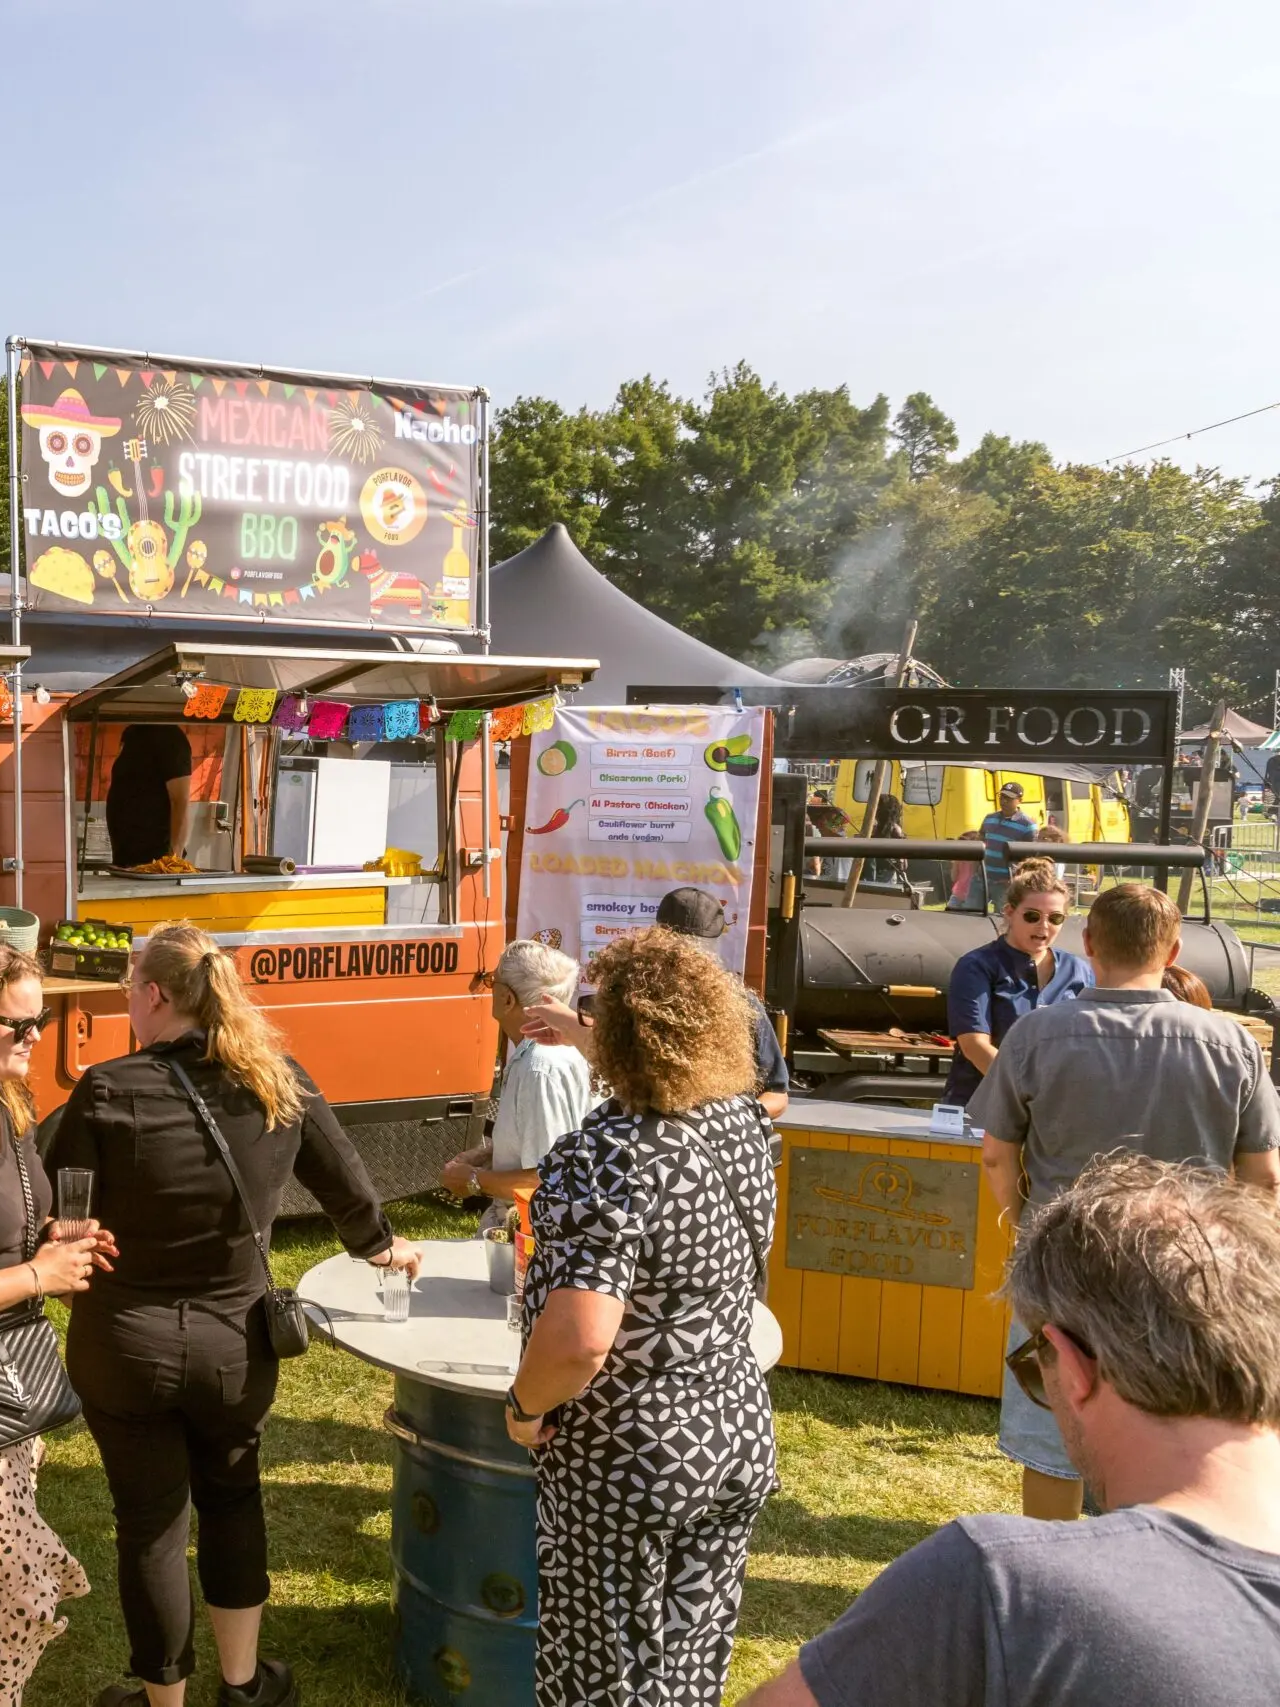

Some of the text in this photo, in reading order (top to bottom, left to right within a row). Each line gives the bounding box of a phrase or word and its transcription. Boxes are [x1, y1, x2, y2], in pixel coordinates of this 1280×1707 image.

[200, 397, 330, 451] MEXICAN
[178, 452, 350, 508] STREETFOOD
[372, 472, 412, 488] PORFLAVOR
[23, 508, 121, 541] TACO'S
[240, 513, 298, 562] BBQ
[984, 706, 1151, 746] FOOD
[606, 748, 676, 759] Birria (Beef)
[656, 774, 687, 783] (Pork)
[604, 800, 641, 809] Pastore
[644, 801, 689, 811] (Chicken)
[598, 820, 675, 829] Cauliflower burnt
[586, 902, 636, 914] smokey
[251, 942, 459, 984] @PORFLAVORFOOD
